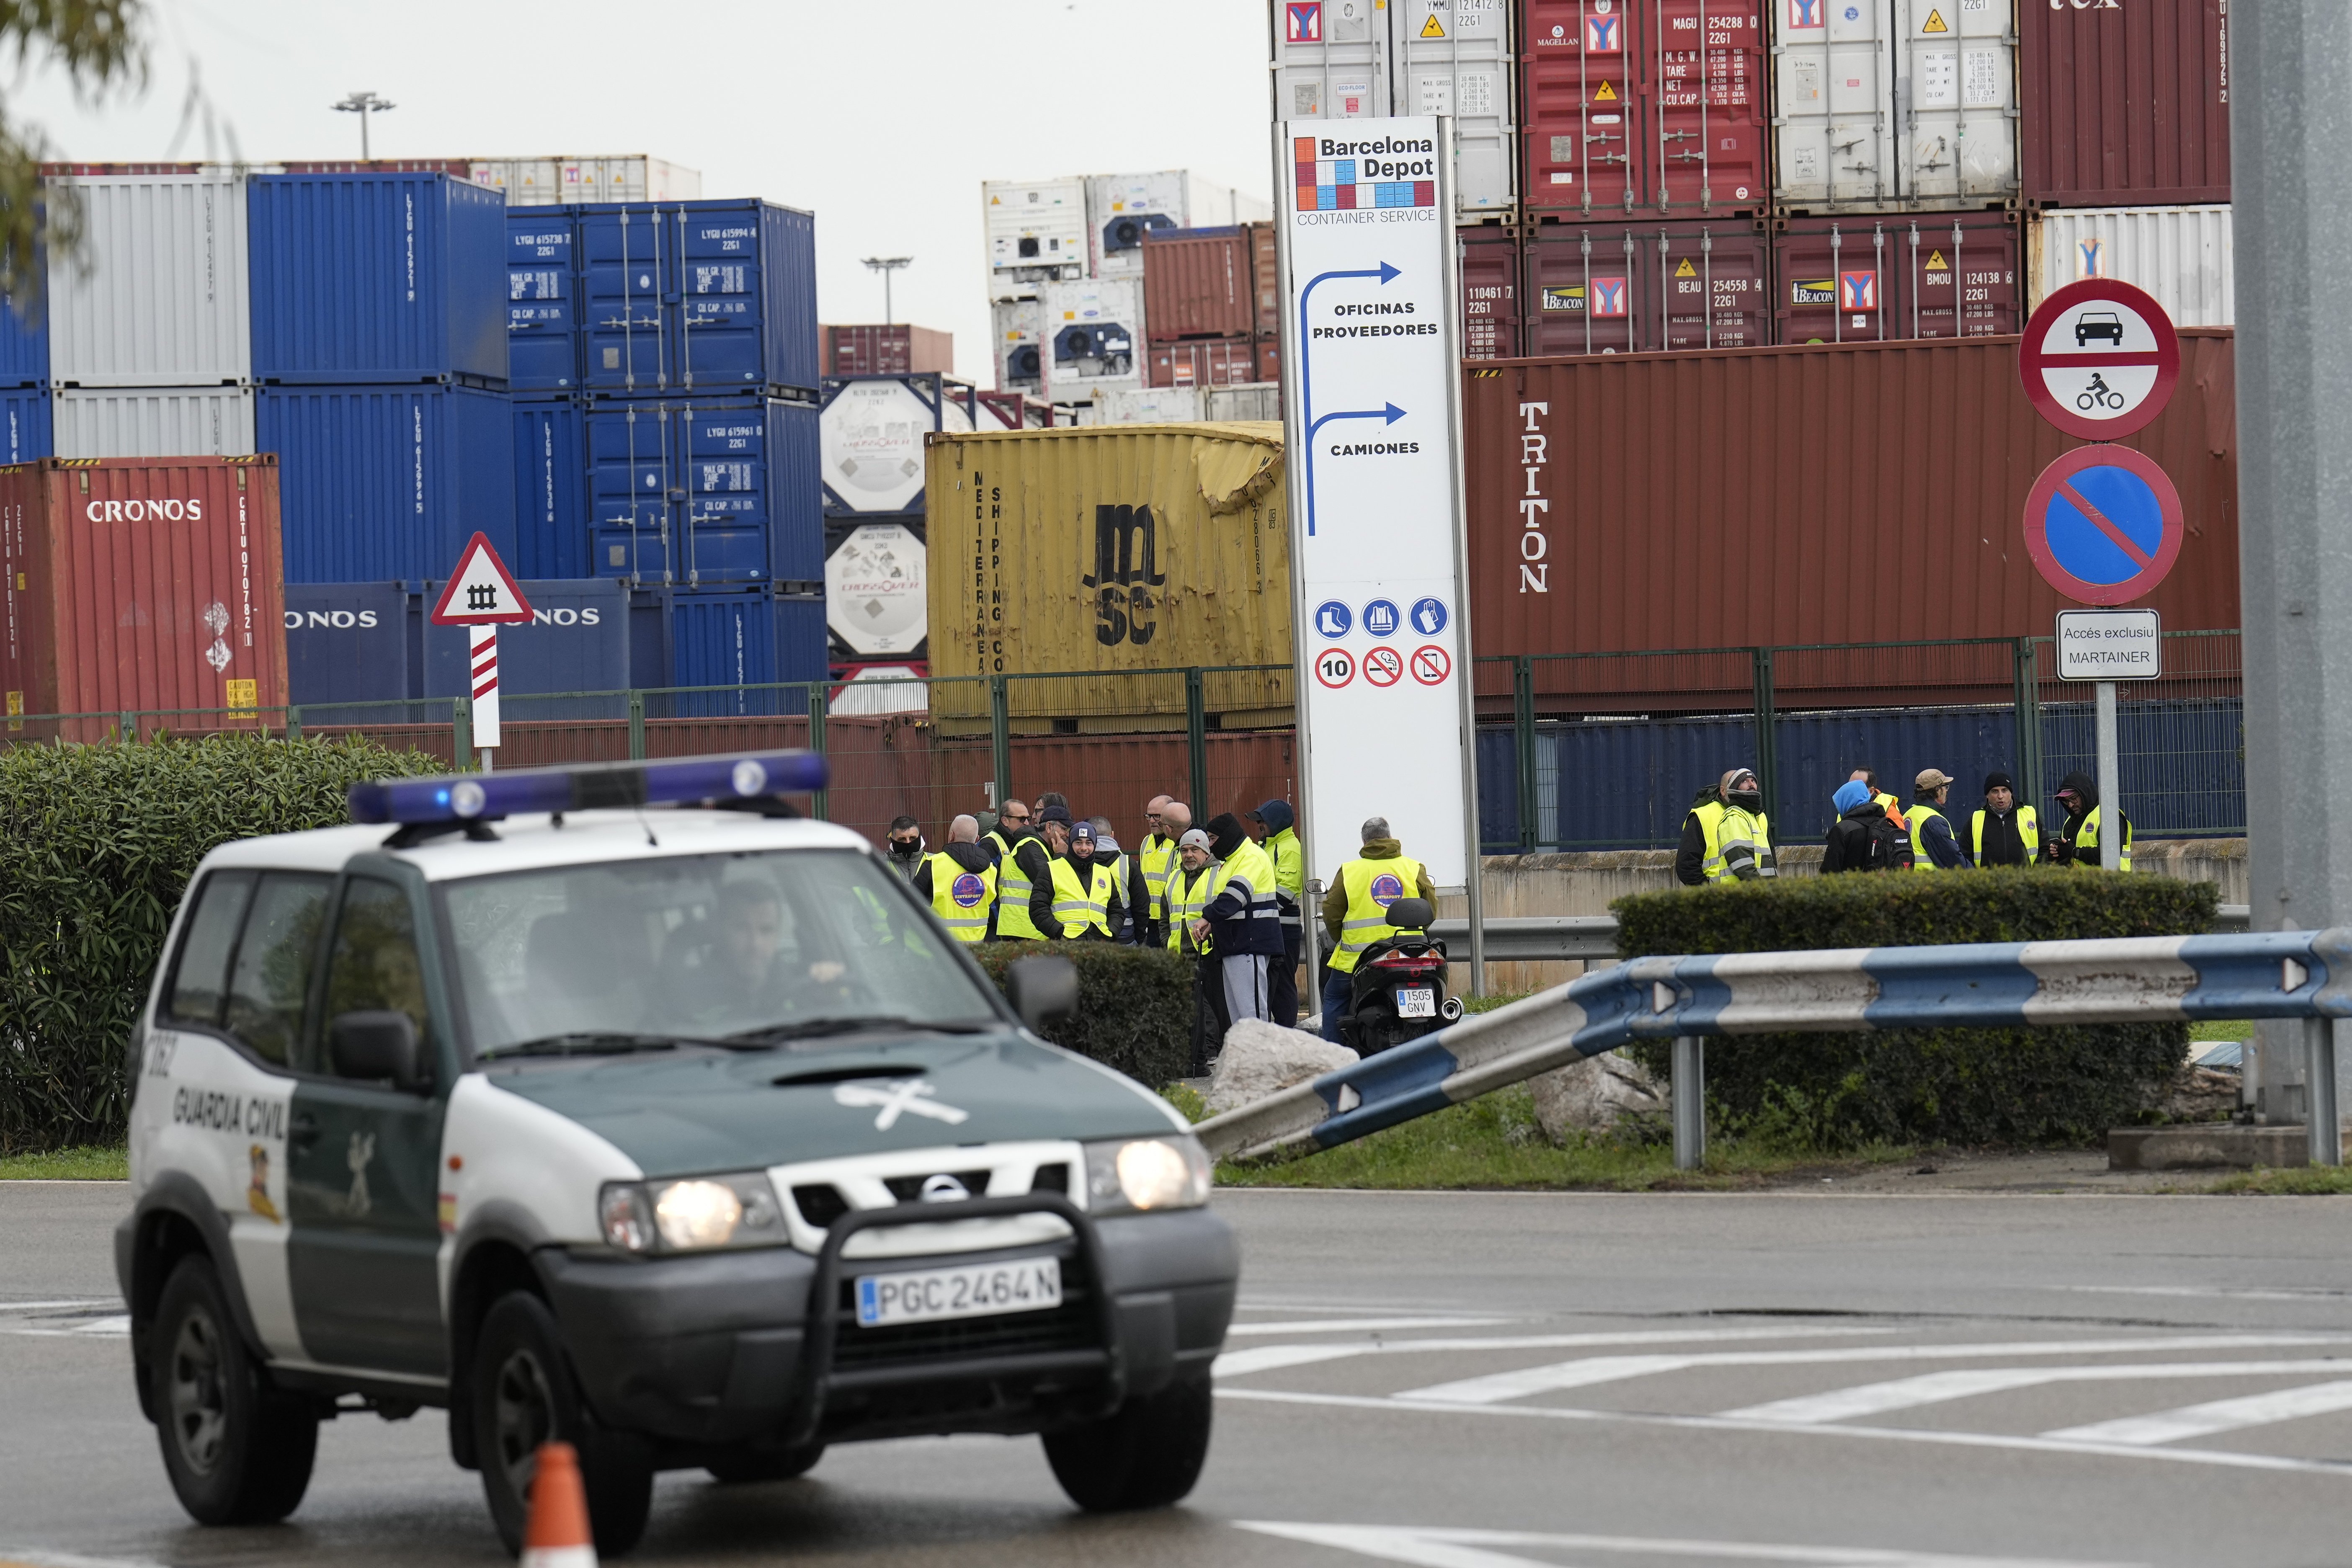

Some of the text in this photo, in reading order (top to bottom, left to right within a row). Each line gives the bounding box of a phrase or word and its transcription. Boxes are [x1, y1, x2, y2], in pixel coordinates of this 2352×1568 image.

[1427, 0, 1503, 10] YMMU 121412 8
[1459, 15, 1480, 26] 22G1
[1673, 15, 1757, 30] MAGU 254288 0
[1709, 32, 1730, 44] 22G1
[1666, 65, 1687, 76] TARE
[1667, 80, 1681, 91] NET
[2220, 90, 2227, 102] 2
[1321, 136, 1433, 156] Barcelona
[1365, 159, 1433, 181] Depot
[1297, 210, 1435, 226] CONTAINER SERVICE
[1927, 272, 2012, 285] BMOU 124138 6
[1469, 286, 1513, 299] 110461 7
[1679, 279, 1761, 293] BEAU 254558 4
[1715, 295, 1736, 307] 22G1
[1799, 290, 1834, 302] BEACON
[1966, 288, 1988, 301] 22G1
[1334, 302, 1415, 316] OFICINAS
[1469, 302, 1490, 313] 22G1
[1548, 297, 1583, 309] BEACON
[1313, 323, 1438, 338] PROVEEDORES
[1331, 442, 1419, 456] CAMIONES
[1519, 402, 1548, 593] TRITON
[87, 499, 201, 522] CRONOS
[992, 487, 1003, 672] SHIPPING CO
[242, 552, 250, 628] 070782
[2064, 626, 2153, 639] Accés exclusiu
[244, 633, 252, 646] 1
[2069, 651, 2150, 663] MARTAINER
[1323, 660, 1347, 676] 10
[1407, 991, 1431, 1001] 1505
[1408, 1002, 1425, 1012] GNV
[173, 1087, 284, 1140] GUARDIA CIVIL
[881, 1266, 1055, 1315] PGC 2464 N
